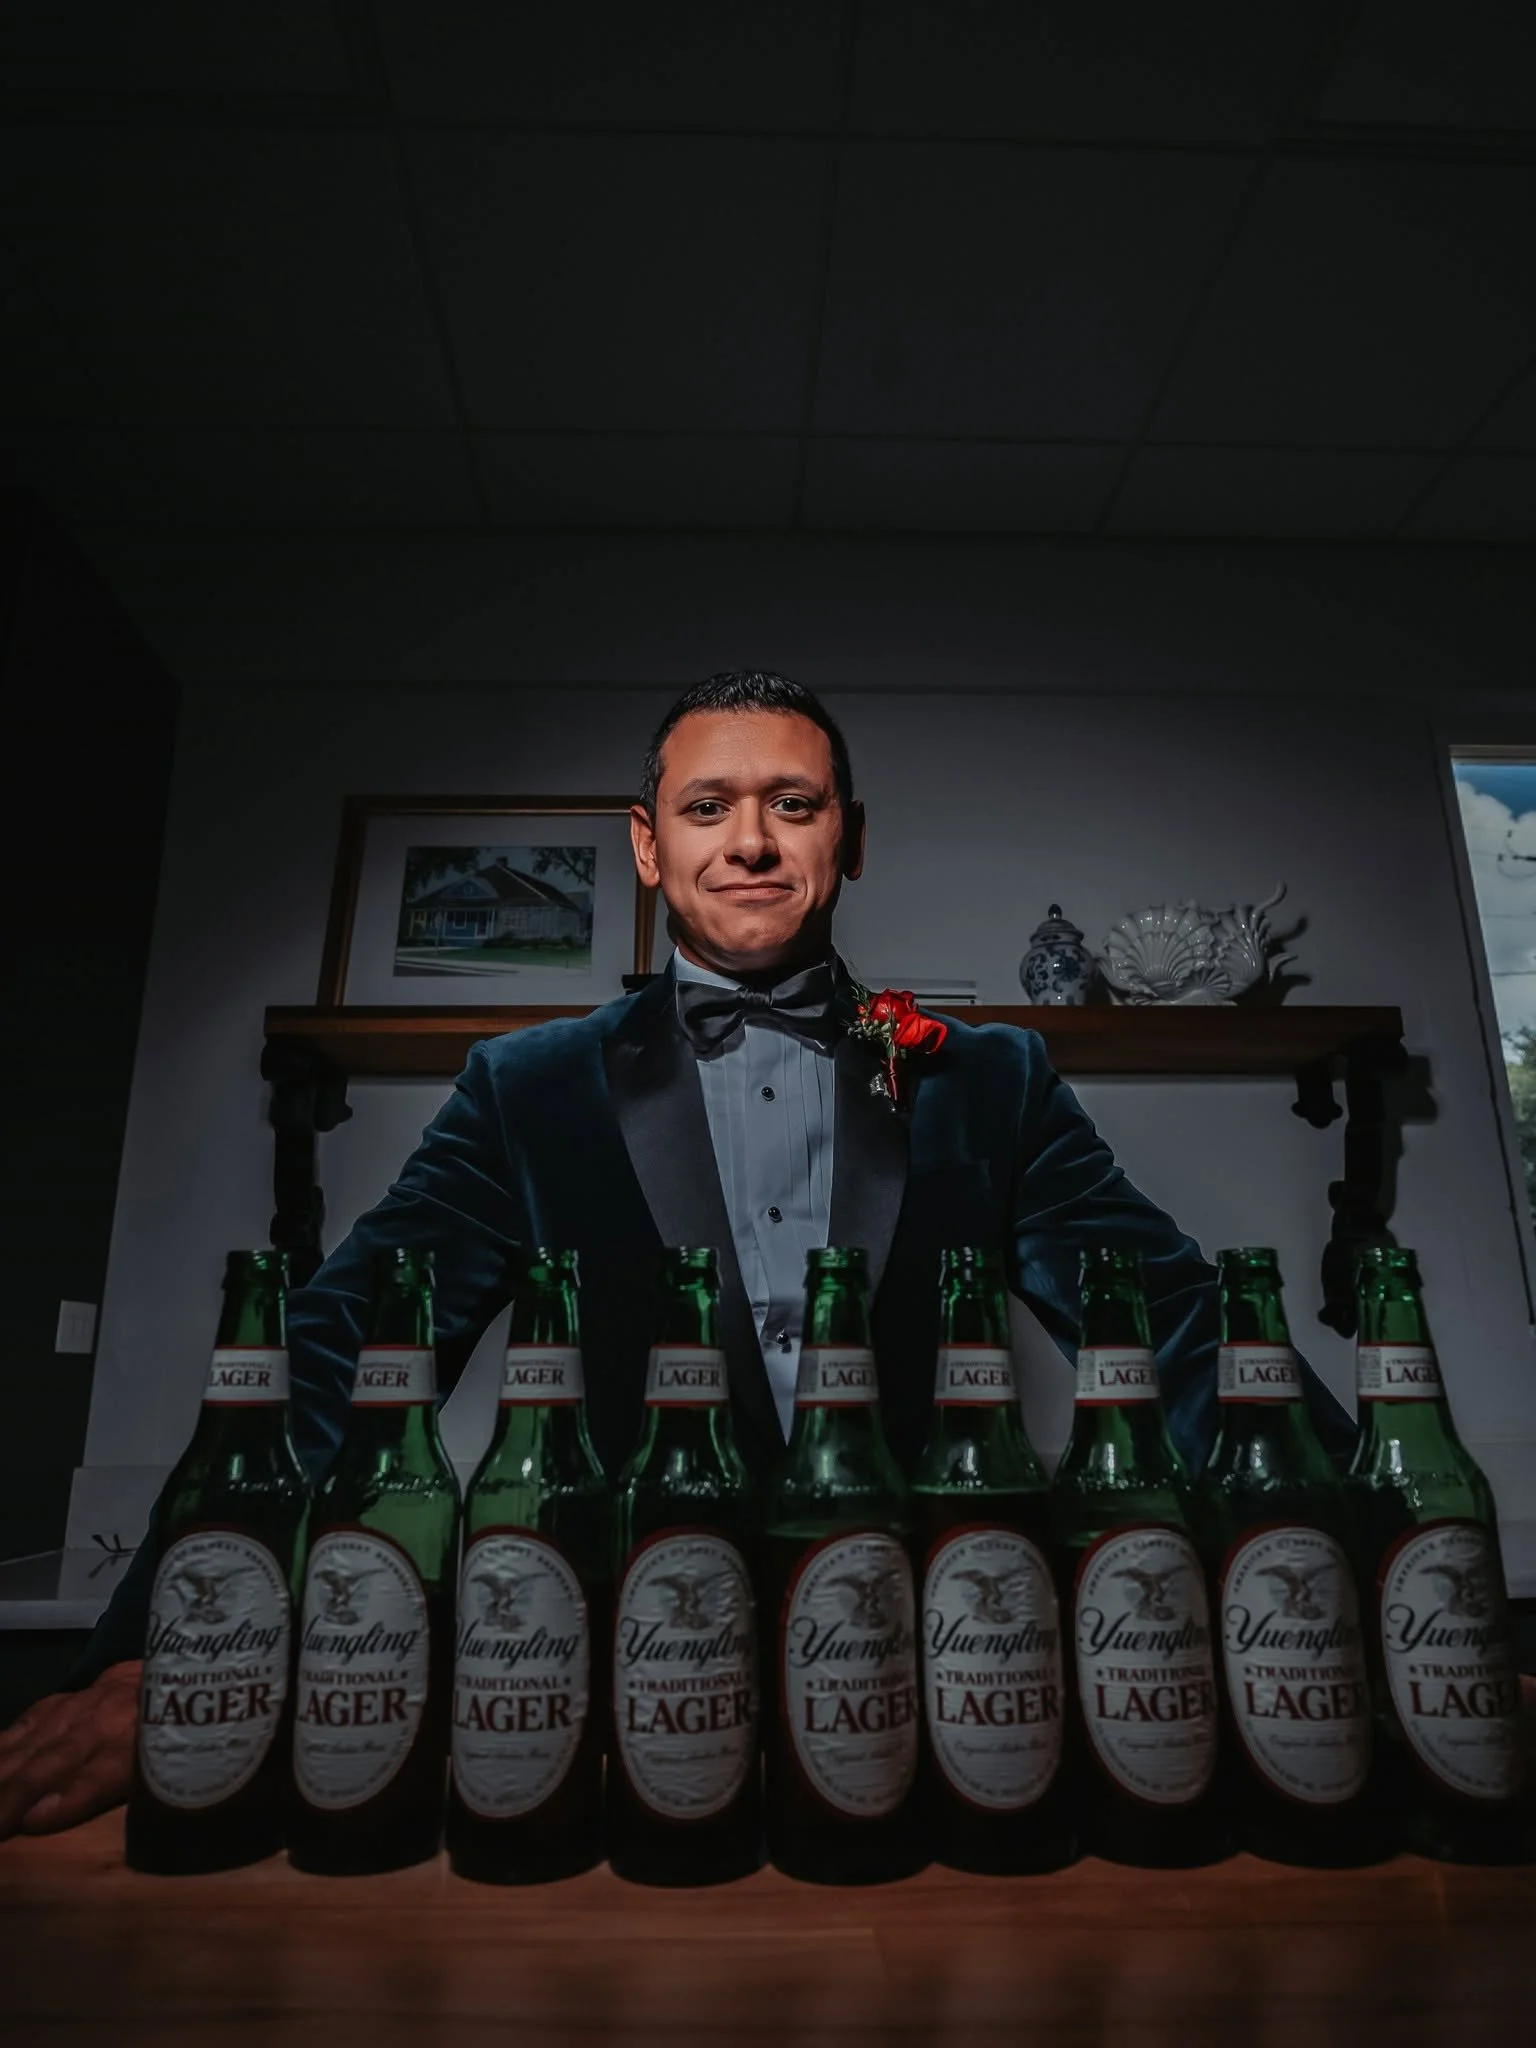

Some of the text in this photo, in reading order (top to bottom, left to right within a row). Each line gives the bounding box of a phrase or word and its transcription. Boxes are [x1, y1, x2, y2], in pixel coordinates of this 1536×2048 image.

[208, 1369, 271, 1388] LAGER
[356, 1370, 409, 1388] AGER
[503, 1368, 565, 1387] LAGER
[658, 1368, 721, 1388] LAGER
[821, 1369, 877, 1388] LAGE
[949, 1368, 1012, 1387] LAGER
[1099, 1368, 1155, 1387] LAGE
[144, 1684, 272, 1727] LAGER
[299, 1687, 409, 1728] AGER
[453, 1690, 572, 1734] LAGER
[626, 1689, 752, 1735] LAGER
[935, 1685, 1059, 1727] LAGER
